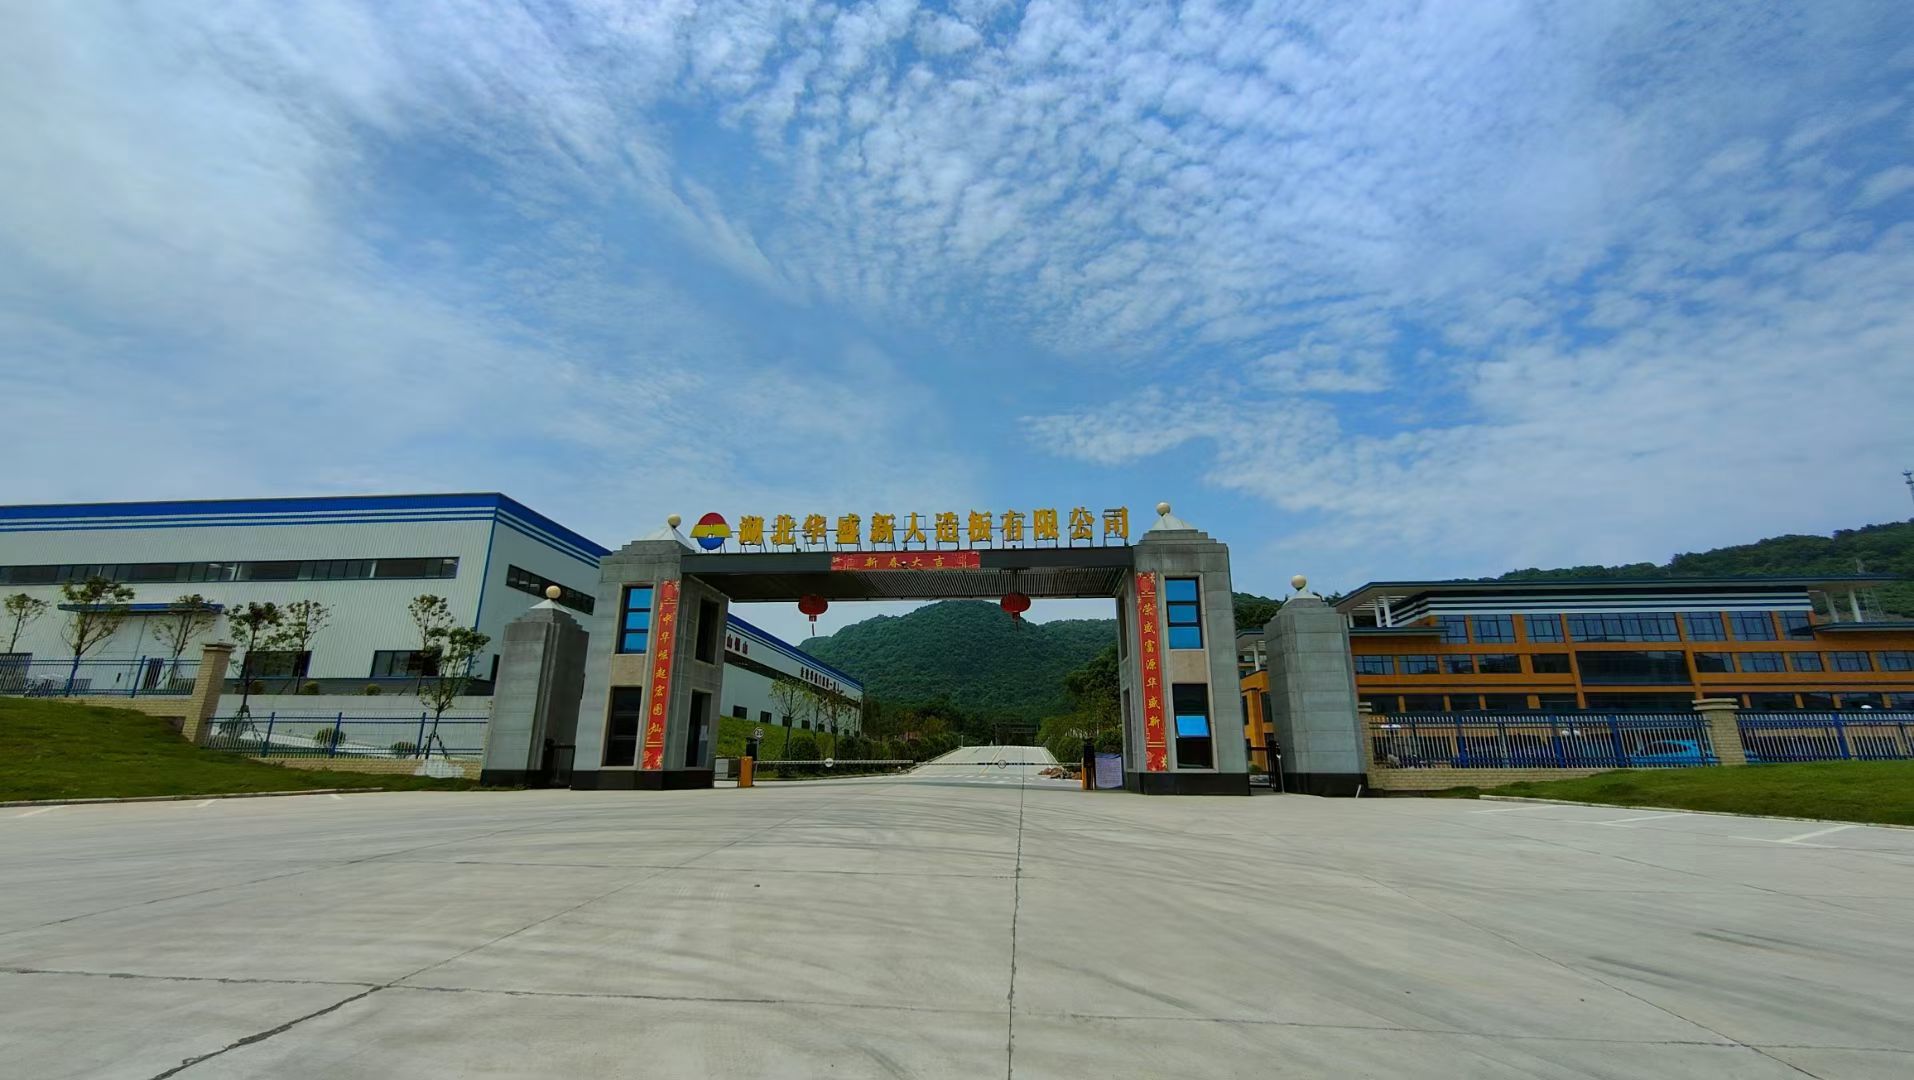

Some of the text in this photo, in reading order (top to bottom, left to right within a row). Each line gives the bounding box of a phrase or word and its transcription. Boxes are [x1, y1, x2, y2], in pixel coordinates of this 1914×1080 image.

[739, 507, 1128, 545] 湖北华盛新人造板有限公司
[864, 555, 945, 568] 新春大吉
